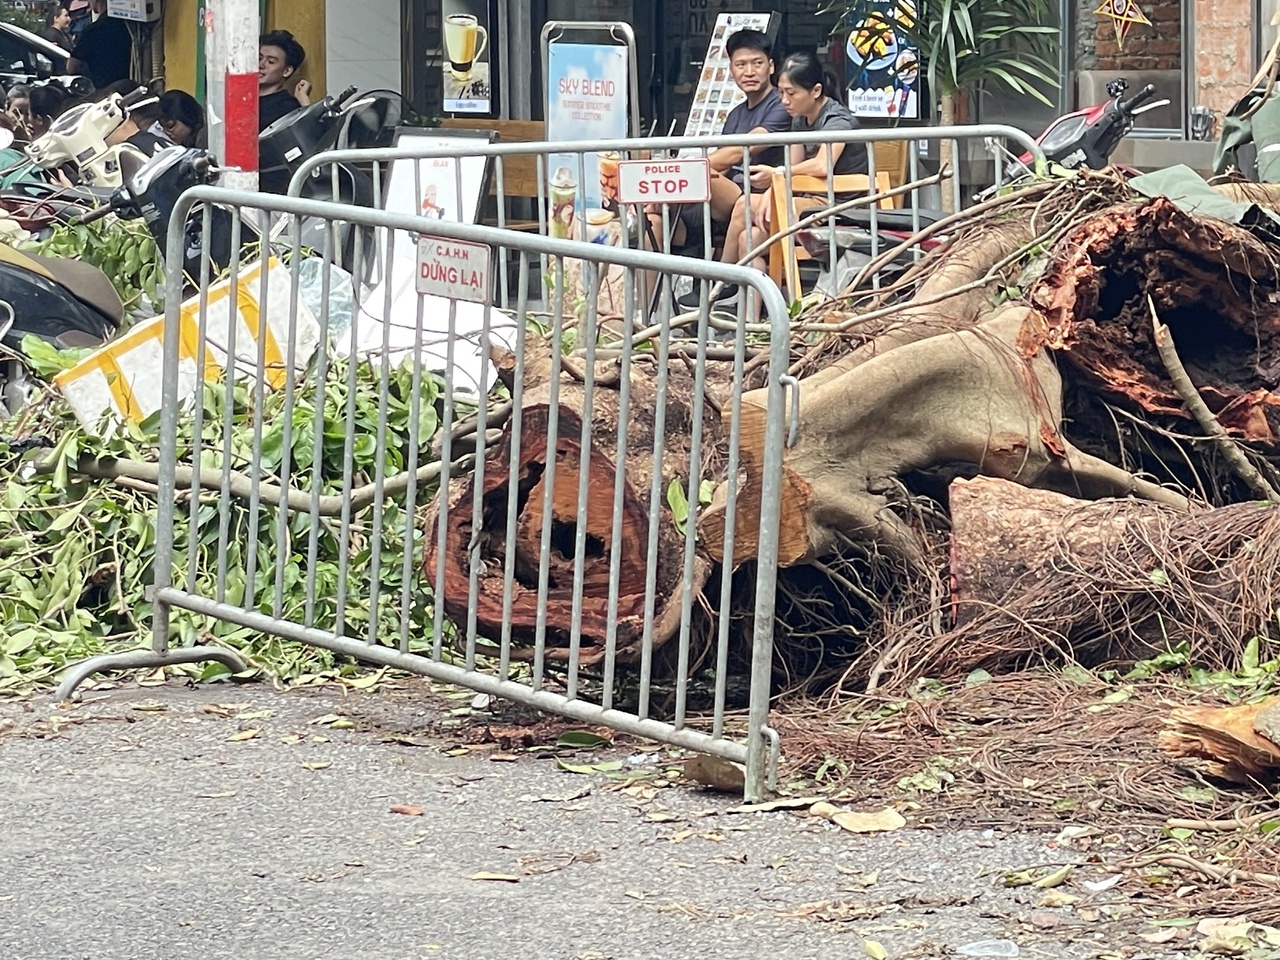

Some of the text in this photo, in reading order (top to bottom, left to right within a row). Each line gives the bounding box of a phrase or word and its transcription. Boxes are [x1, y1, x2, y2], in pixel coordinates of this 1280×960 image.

[558, 77, 616, 97] SKY BLEND
[644, 165, 681, 175] POLICE
[638, 179, 689, 195] STOP
[421, 258, 483, 292] DỪNG LẠI
